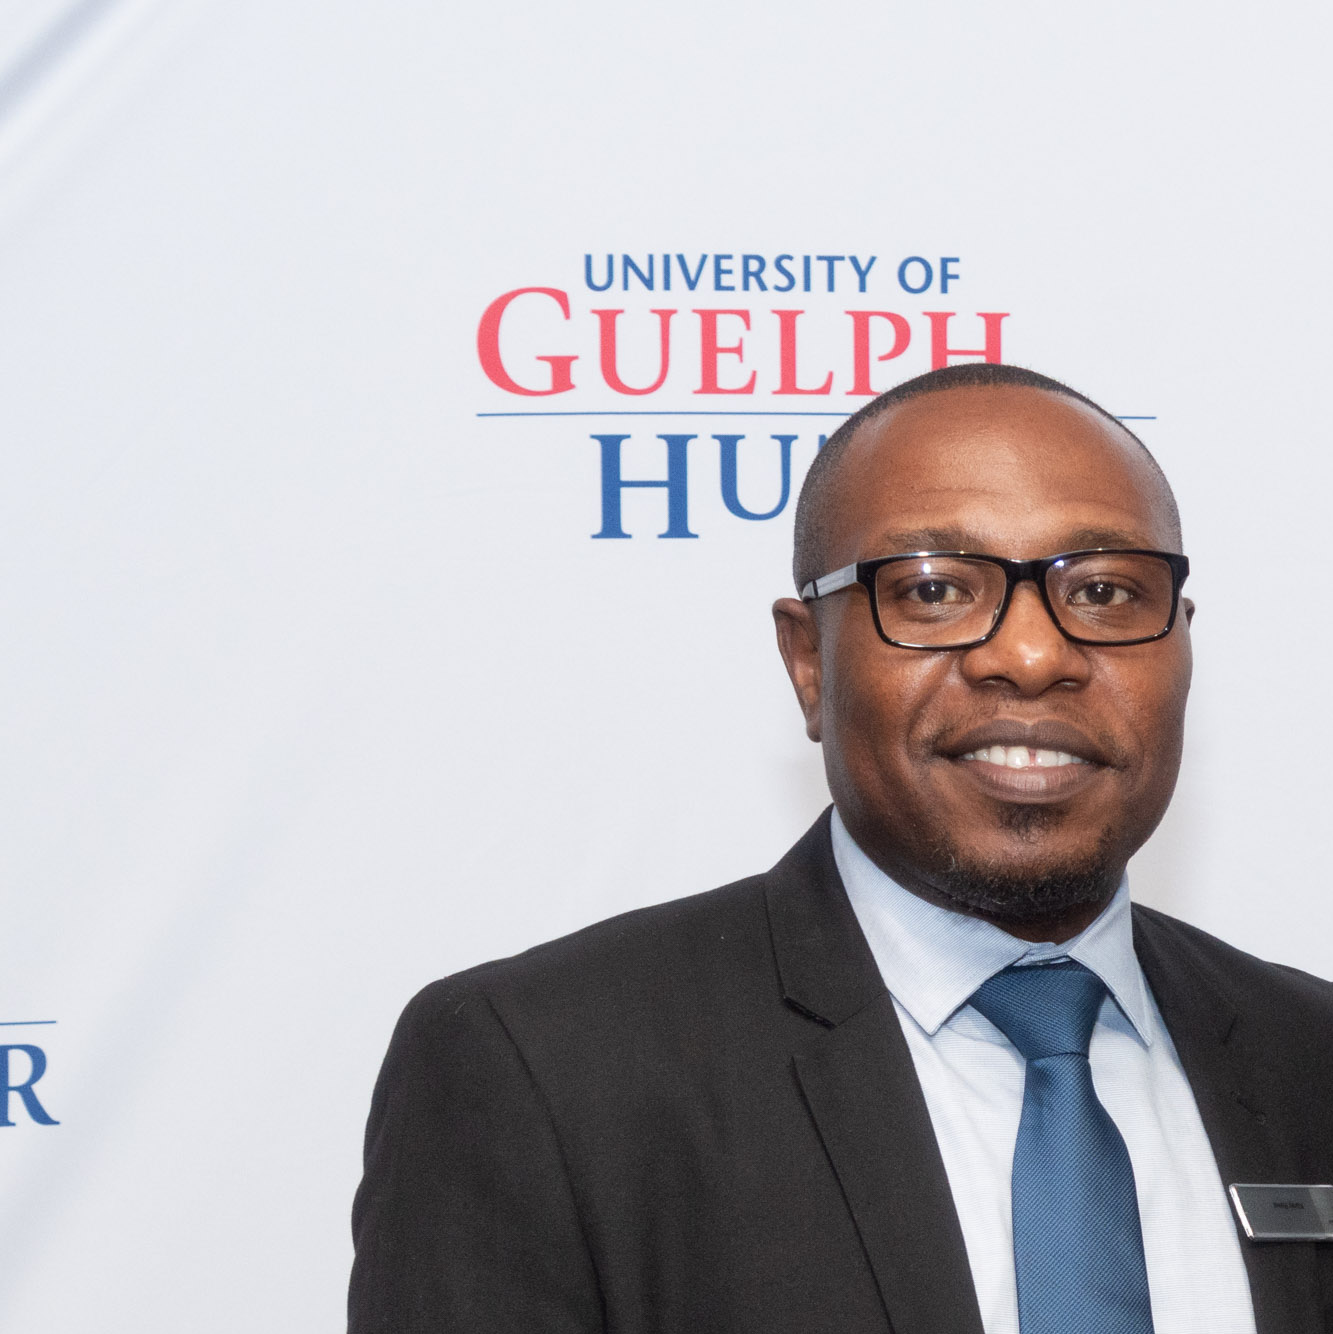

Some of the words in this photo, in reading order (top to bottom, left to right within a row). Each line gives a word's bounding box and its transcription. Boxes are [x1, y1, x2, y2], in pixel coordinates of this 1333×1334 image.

[585, 253, 878, 294] UNIVERSITY
[898, 256, 962, 296] OF
[476, 287, 1010, 397] GUELPH
[590, 434, 828, 540] HU
